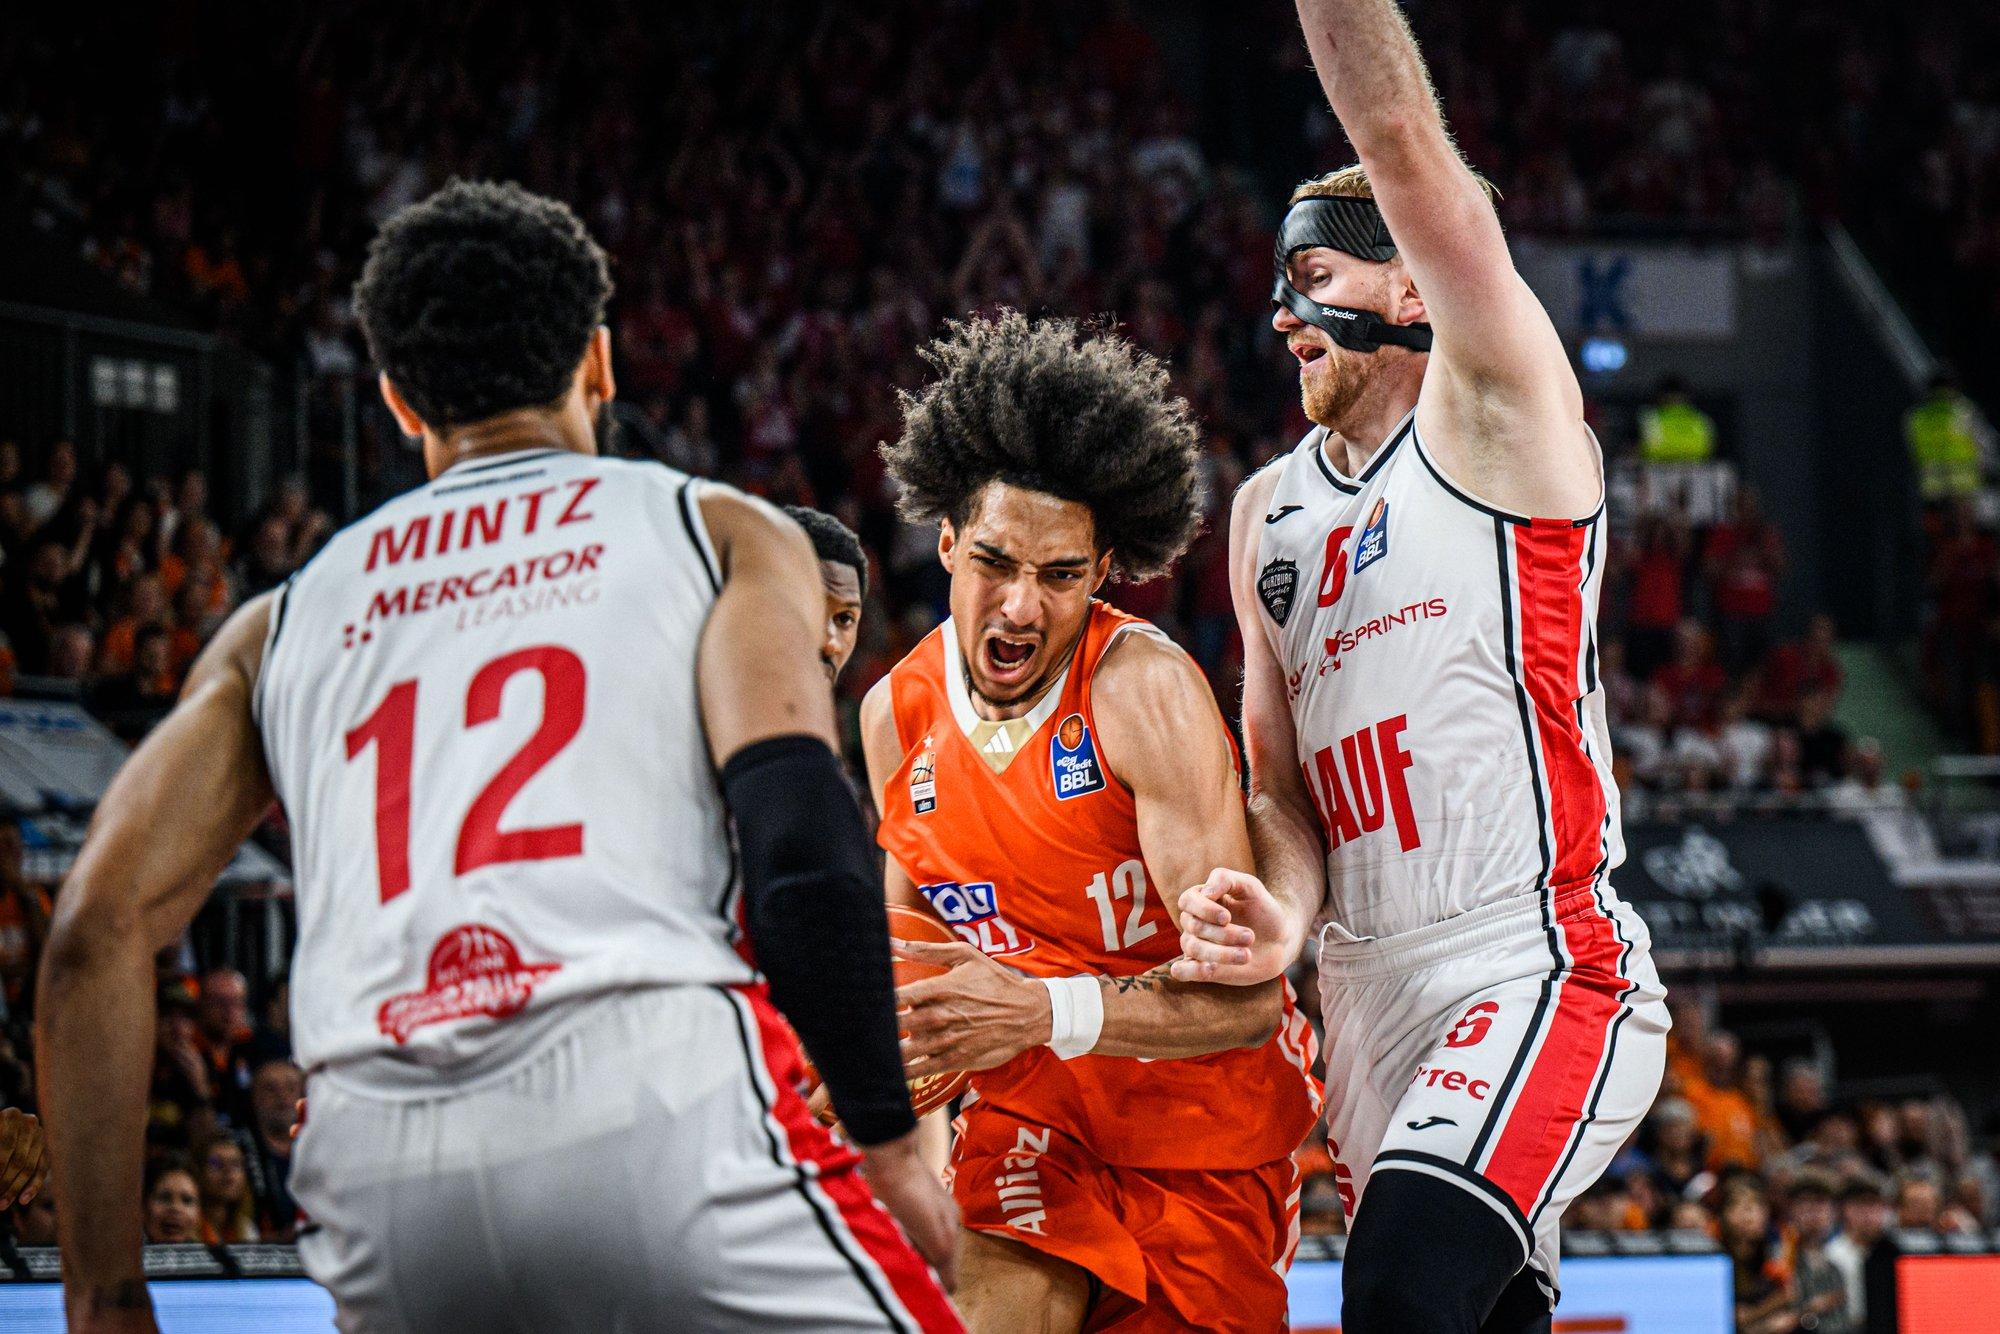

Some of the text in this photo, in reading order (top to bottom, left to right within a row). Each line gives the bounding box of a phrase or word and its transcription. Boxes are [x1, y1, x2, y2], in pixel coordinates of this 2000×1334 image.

[1321, 306, 1358, 321] Scheder
[364, 477, 601, 573] MINTZ
[1356, 541, 1383, 568] BBL
[366, 543, 604, 622] MERCATOR
[455, 577, 600, 632] LEASING
[1341, 598, 1448, 652] SPRINTIS
[345, 644, 587, 906] 12
[1060, 768, 1097, 793] BBL
[1301, 713, 1421, 857] AUF
[1085, 859, 1158, 953] 12
[1443, 1001, 1499, 1048] 6
[994, 1127, 1051, 1237] Alliaz
